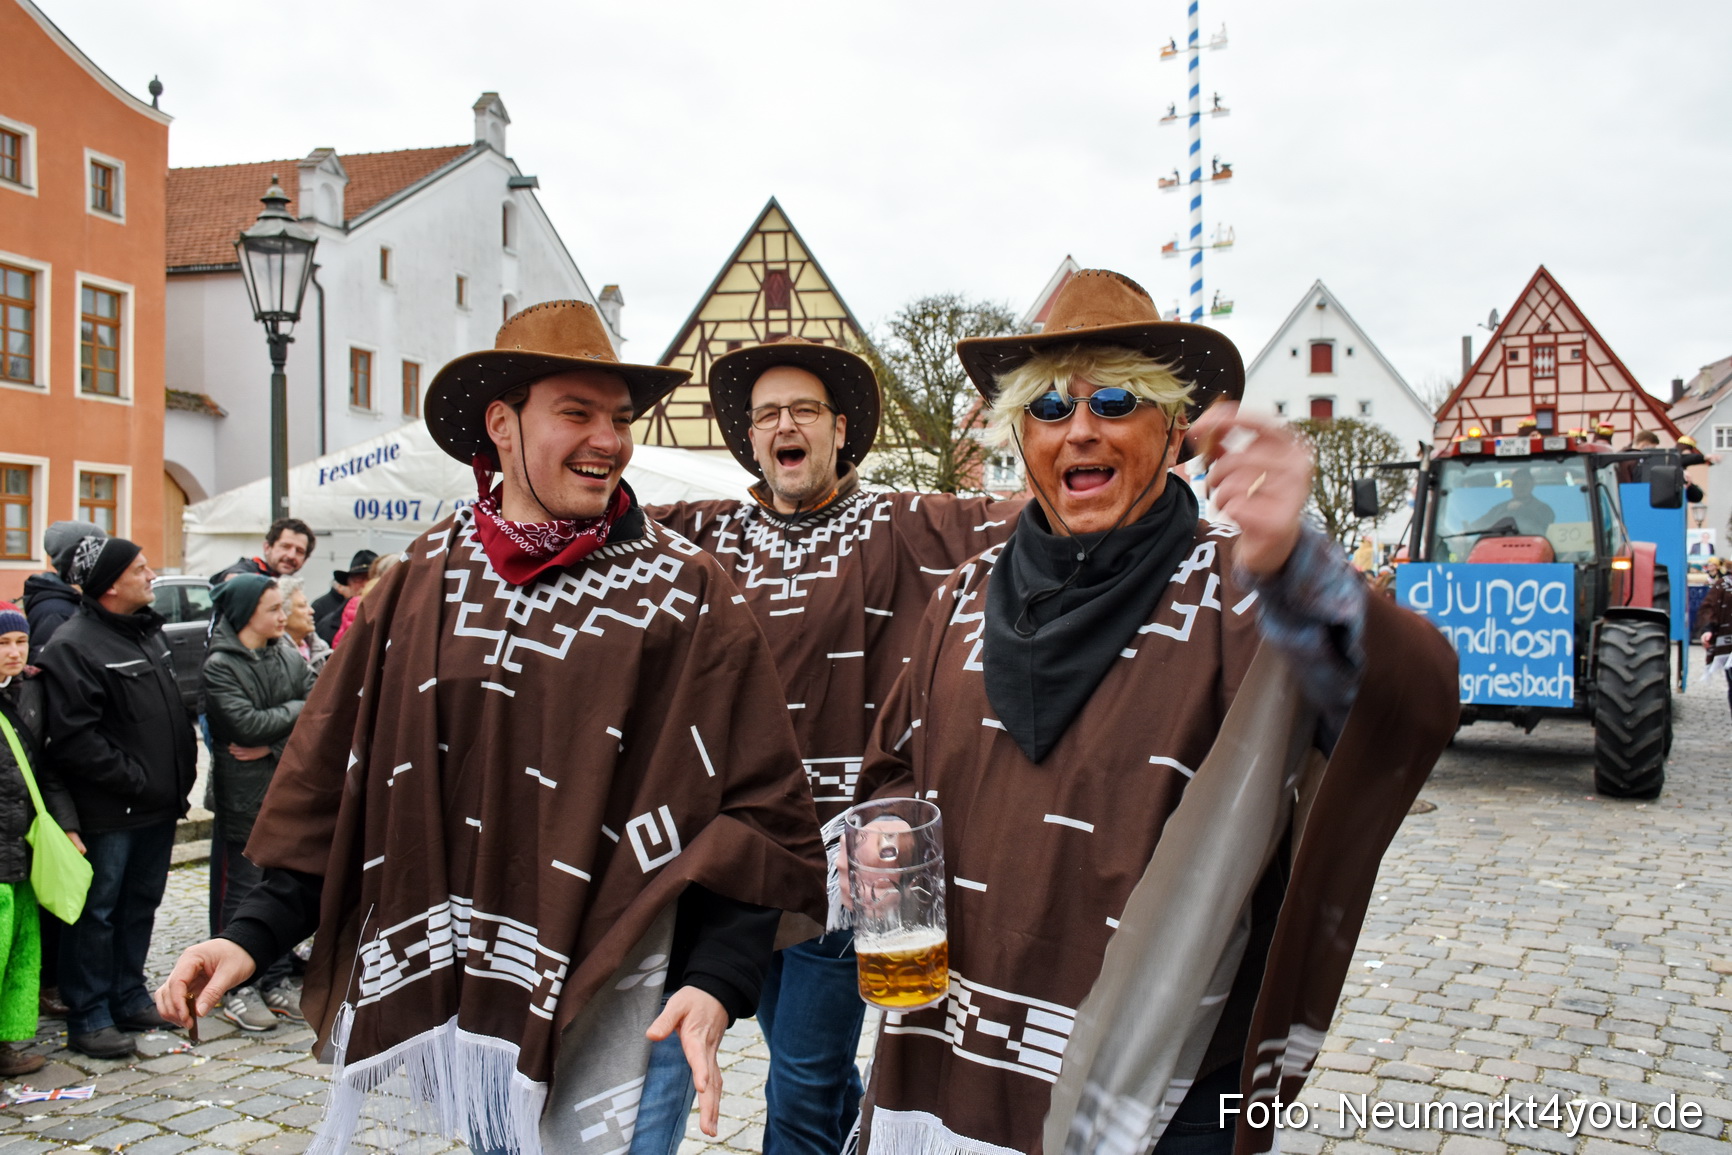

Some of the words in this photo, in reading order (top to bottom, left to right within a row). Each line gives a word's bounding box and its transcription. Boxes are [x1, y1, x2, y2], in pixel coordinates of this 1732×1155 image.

[318, 442, 401, 486] Festzelte
[354, 498, 422, 521] 09497
[1557, 526, 1582, 543] 30
[1458, 662, 1574, 704] griesbach
